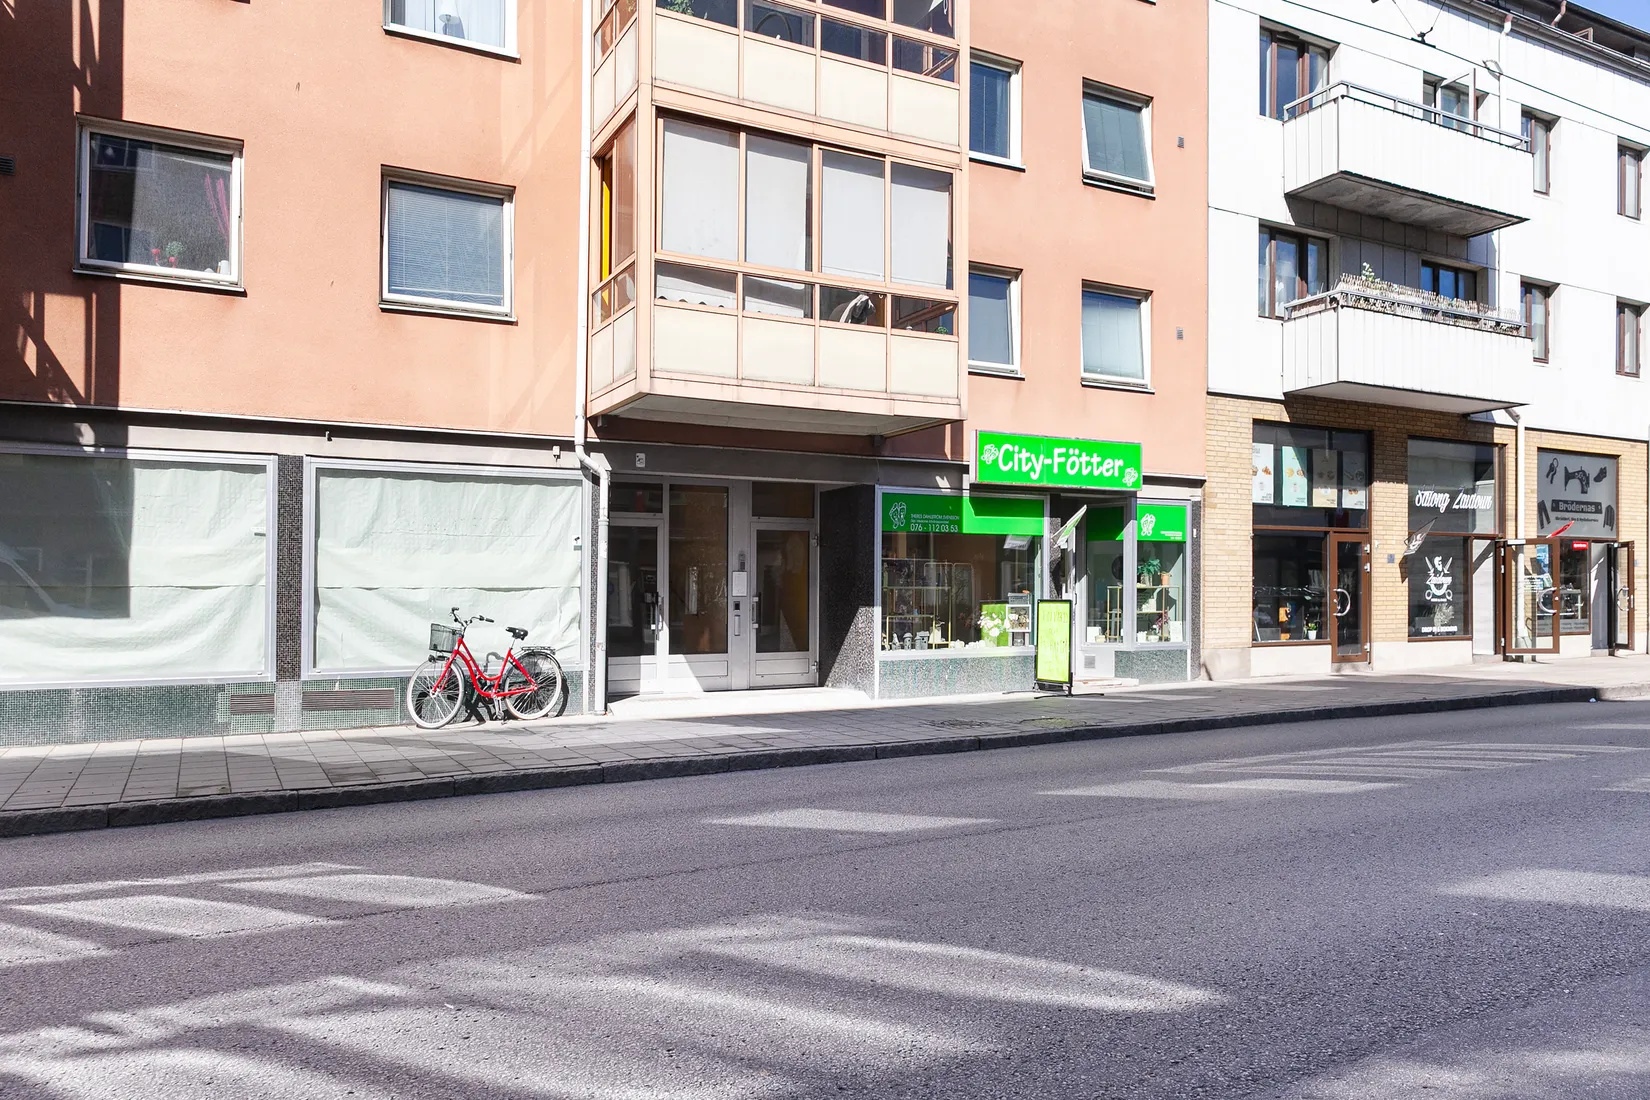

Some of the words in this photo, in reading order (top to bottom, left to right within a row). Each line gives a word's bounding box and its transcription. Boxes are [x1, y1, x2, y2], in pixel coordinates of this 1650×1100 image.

[998, 443, 1124, 480] City-Fötter
[1559, 501, 1596, 512] Brödernas
[910, 523, 922, 531] 076
[941, 524, 949, 532] 03
